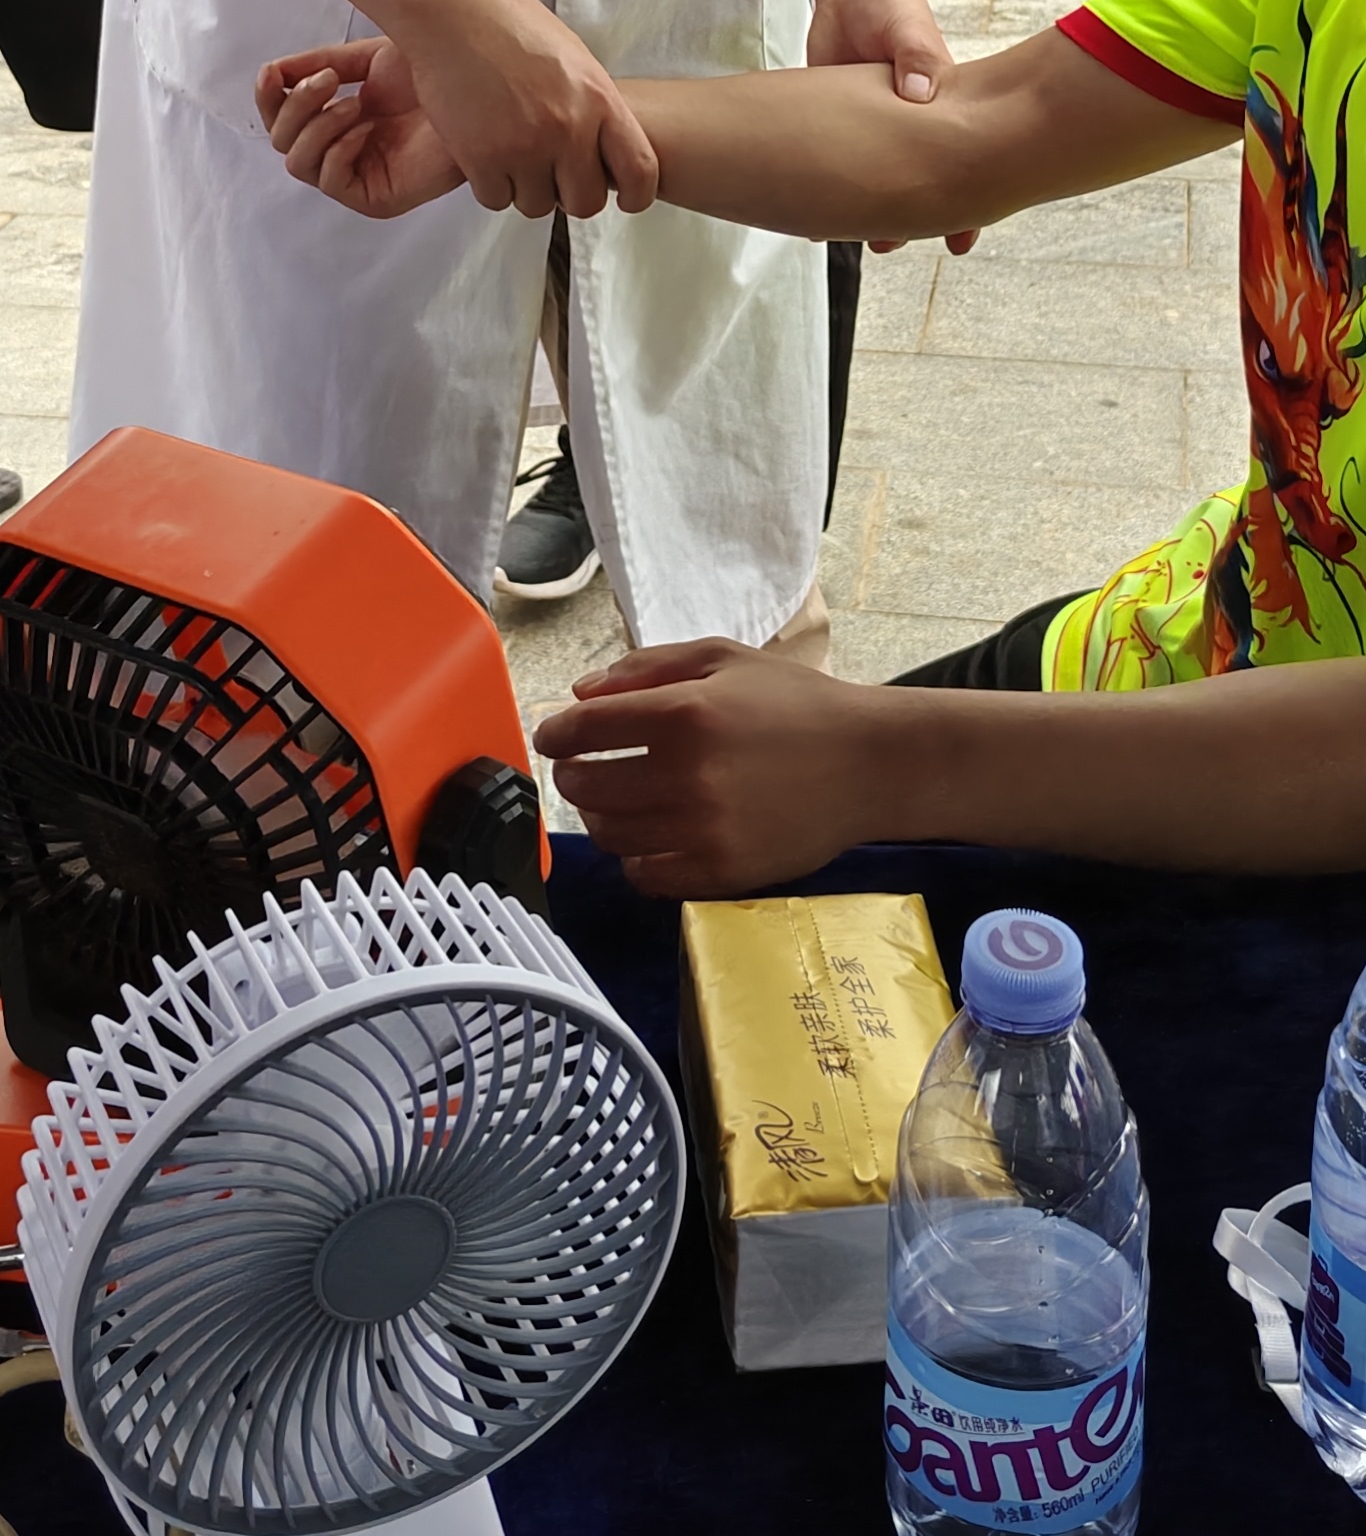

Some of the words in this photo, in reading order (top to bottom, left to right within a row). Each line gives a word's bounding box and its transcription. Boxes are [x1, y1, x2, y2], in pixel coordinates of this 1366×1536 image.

[789, 991, 858, 1080] 柔软亲肤
[829, 955, 897, 1040] 柔护全家
[751, 1098, 829, 1183] 清风
[959, 1413, 1024, 1434] 饮用纯净水
[1041, 1492, 1085, 1520] 560ml
